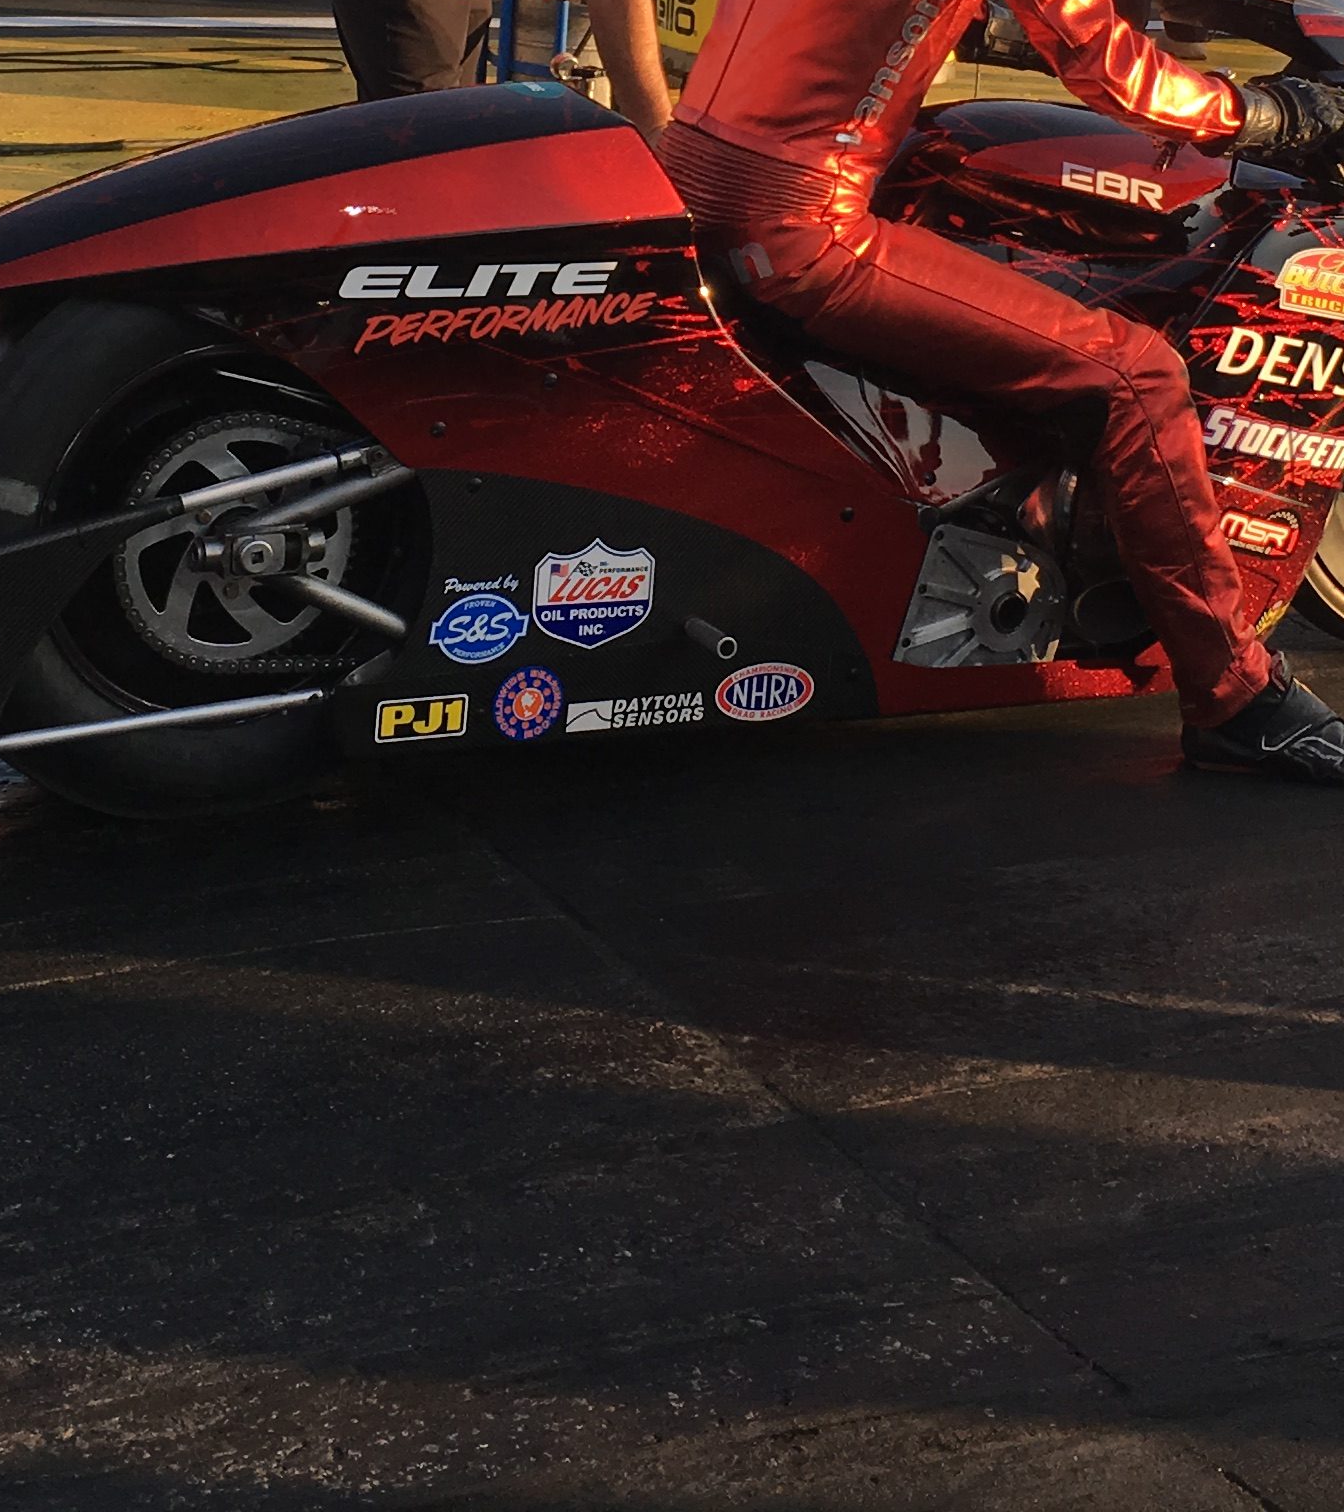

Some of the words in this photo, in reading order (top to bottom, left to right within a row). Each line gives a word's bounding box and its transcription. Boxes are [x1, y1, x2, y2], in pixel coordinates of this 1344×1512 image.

[1061, 161, 1164, 210] EBR
[338, 261, 619, 299] ELITE
[354, 292, 658, 355] PERFORMANCE
[1220, 511, 1291, 548] MSR
[599, 565, 649, 575] PERFORMANCE
[444, 578, 500, 595] Powered
[503, 573, 520, 591] by
[549, 574, 646, 604] LUCAS
[464, 599, 497, 611] PROVEN
[541, 609, 566, 622] OIL
[569, 604, 644, 620] PRODUCTS
[444, 612, 513, 645] S&S
[451, 642, 506, 660] PERFORMANCE
[732, 664, 799, 683] CHAMPIONSHIP
[613, 691, 704, 713] DAYTONA
[731, 675, 799, 710] NHRA
[380, 699, 464, 739] PJ1
[611, 707, 705, 729] SENSORS
[730, 707, 757, 719] DRAG
[758, 702, 800, 718] RACING
